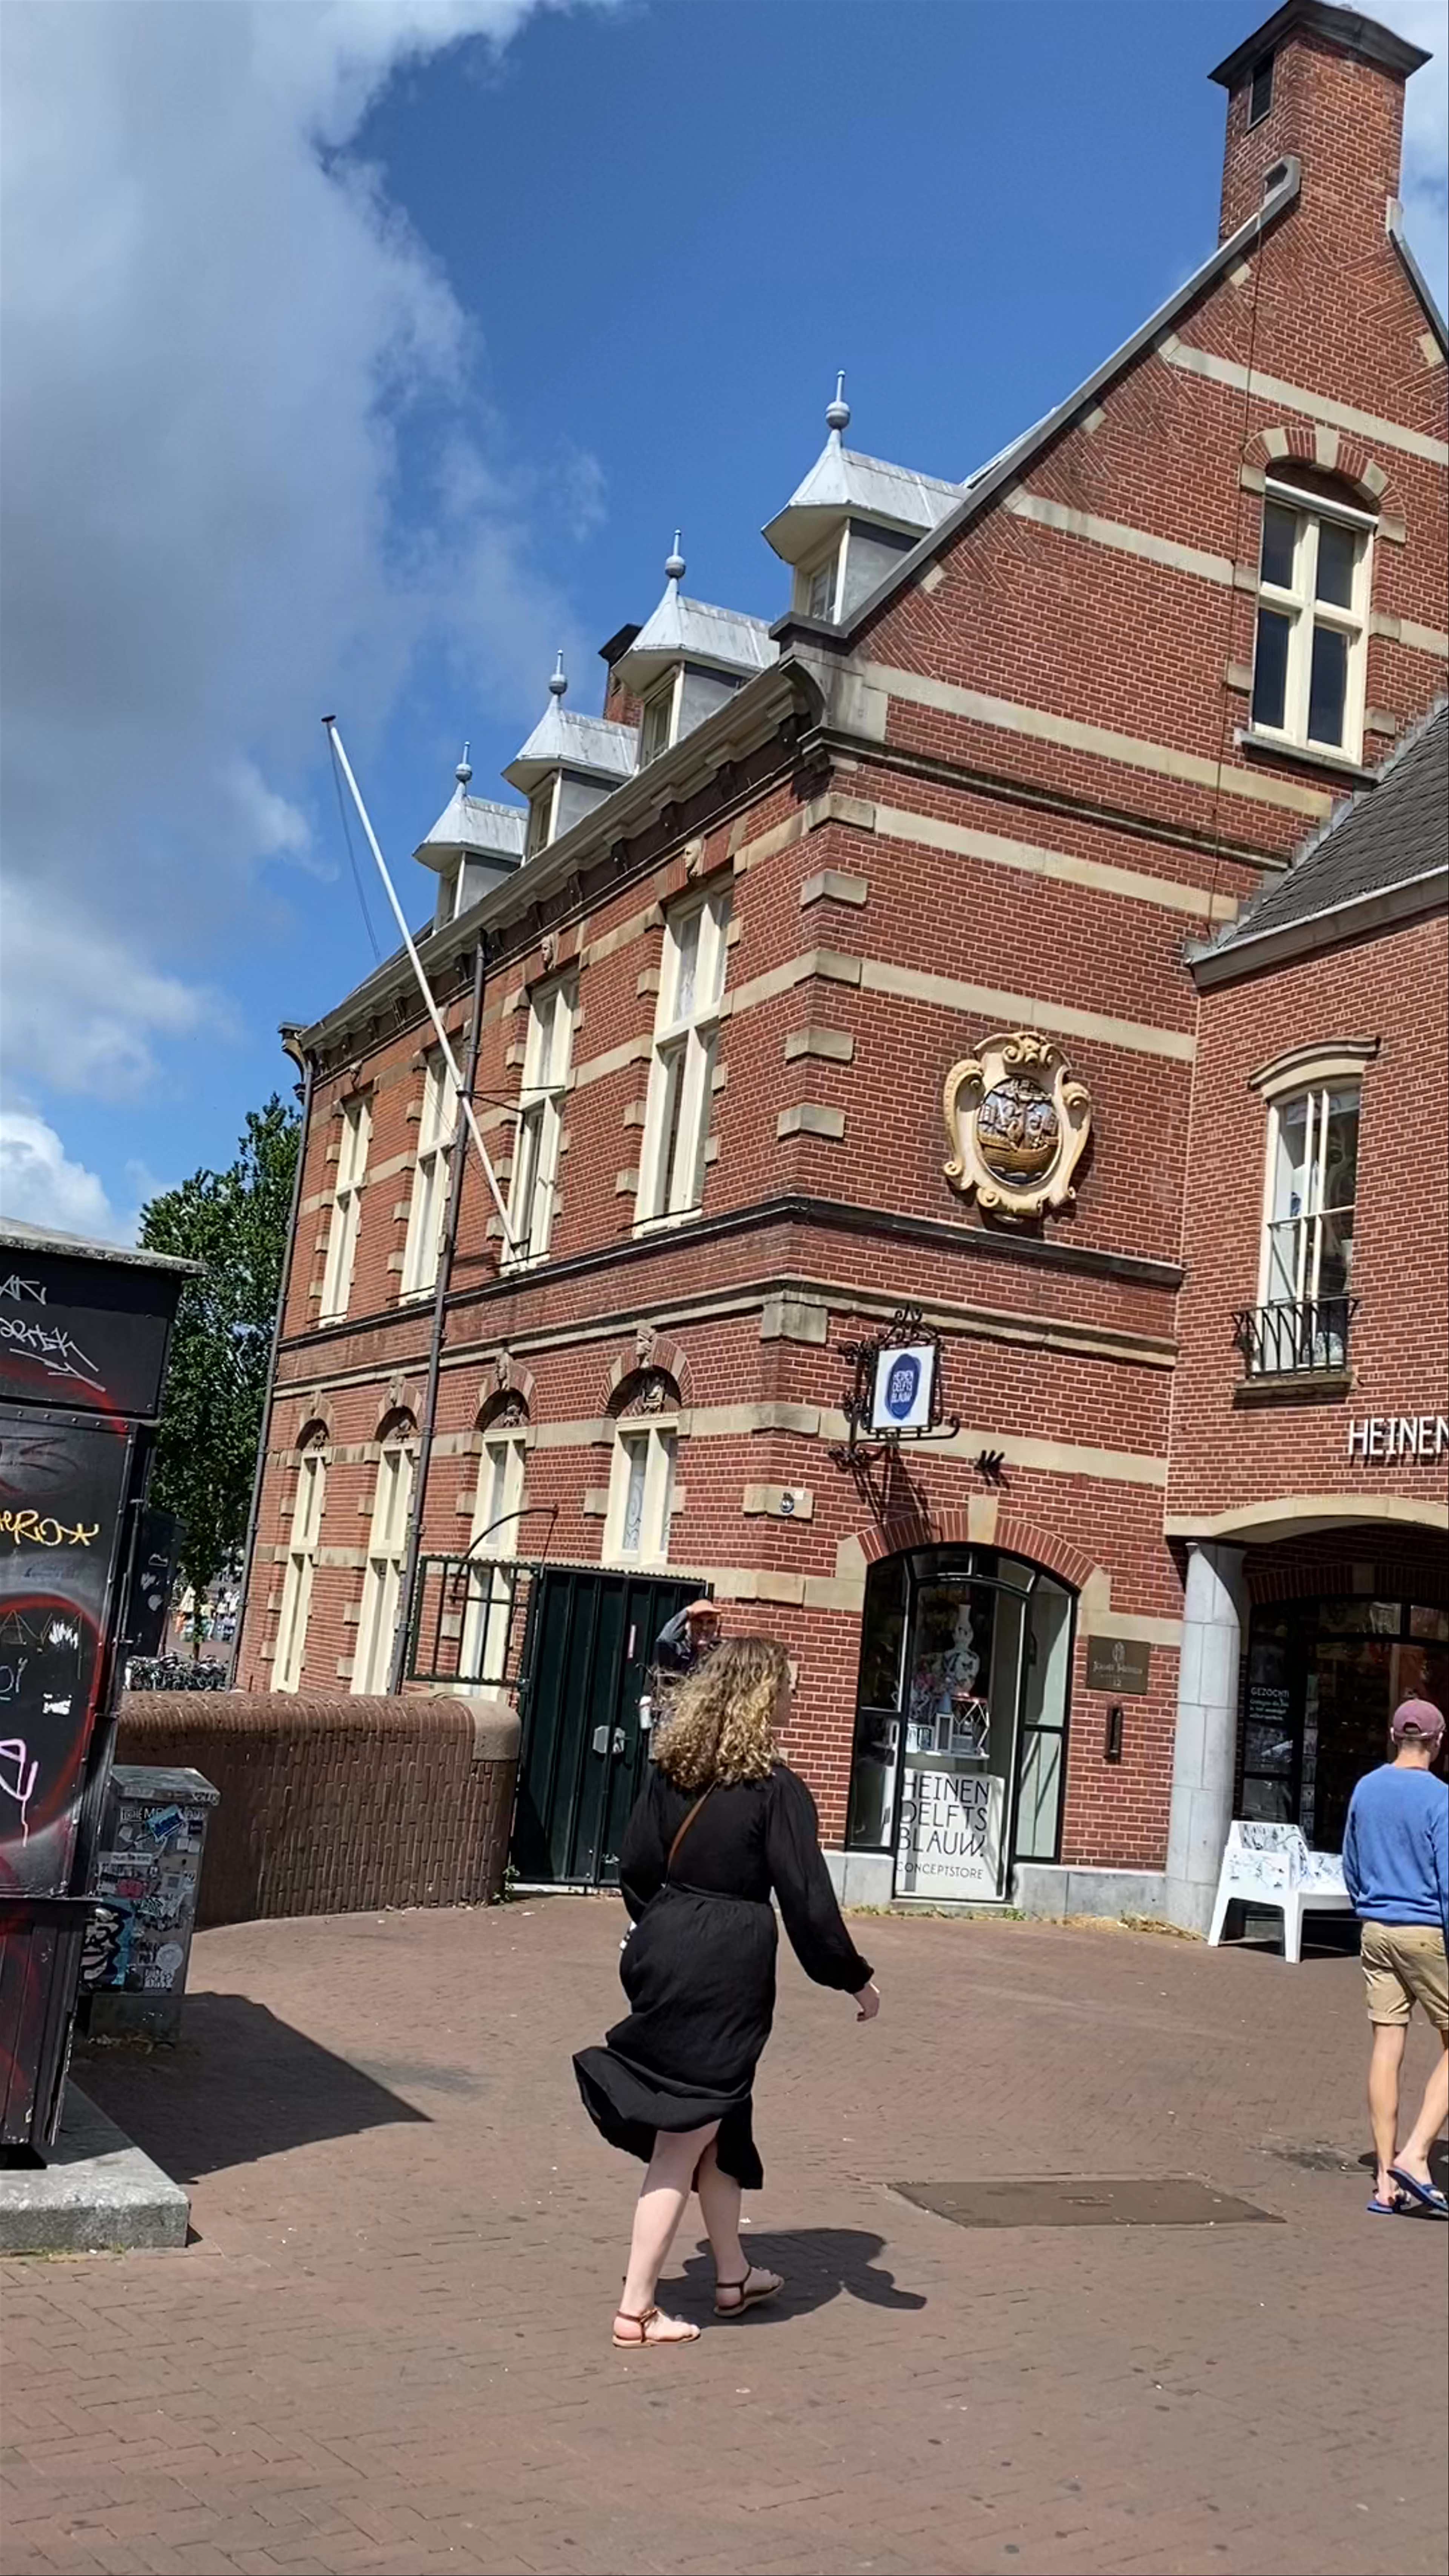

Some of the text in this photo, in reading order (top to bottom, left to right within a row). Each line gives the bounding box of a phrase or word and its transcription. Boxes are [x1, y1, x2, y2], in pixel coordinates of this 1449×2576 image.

[1348, 1416, 1448, 1455] HEINEN
[904, 1773, 989, 1805] HEINEN
[901, 1800, 988, 1831] DELFTS
[898, 1827, 985, 1857] BLAUW.
[897, 1861, 984, 1879] CONCEPTSTORE
